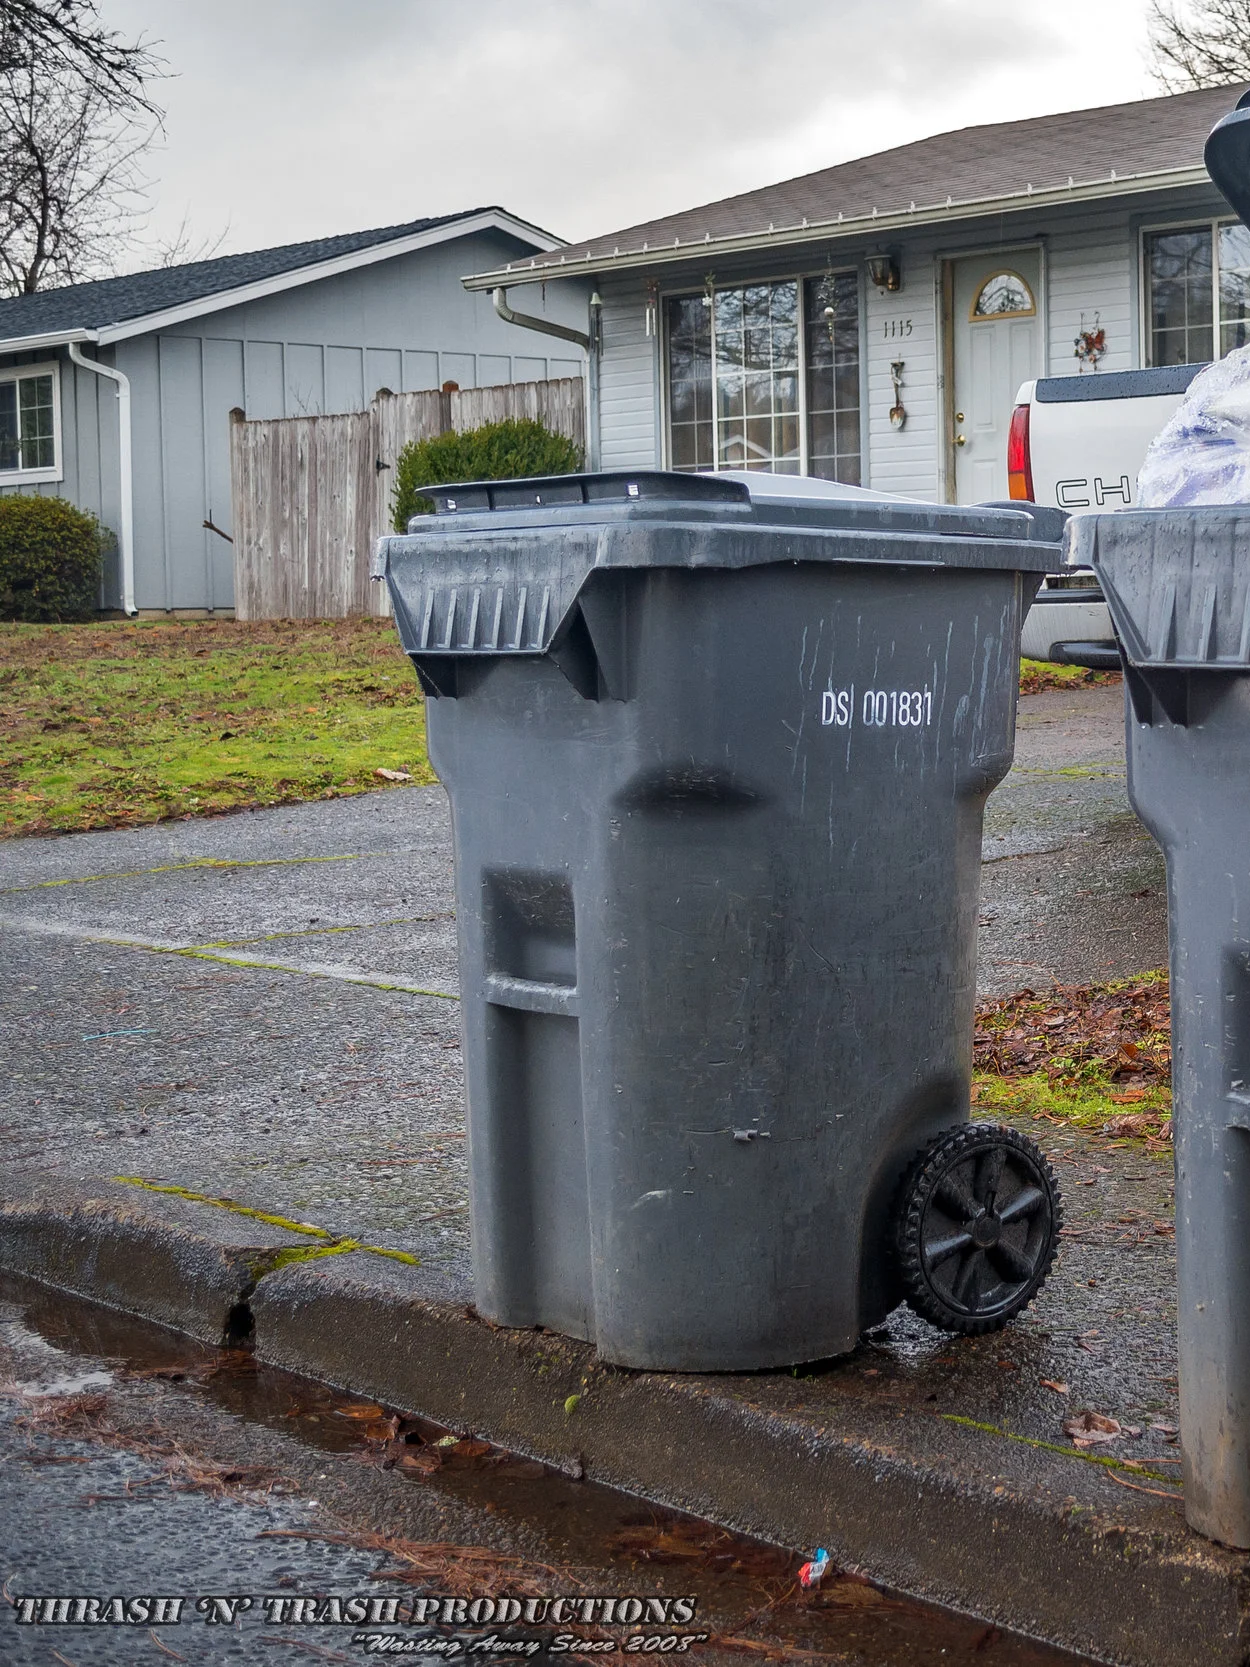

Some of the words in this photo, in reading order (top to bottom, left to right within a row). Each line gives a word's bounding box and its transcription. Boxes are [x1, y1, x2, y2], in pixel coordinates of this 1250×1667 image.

[884, 319, 913, 338] 1115
[1055, 475, 1138, 508] CH
[821, 691, 849, 726] DS
[862, 690, 932, 727] 001831
